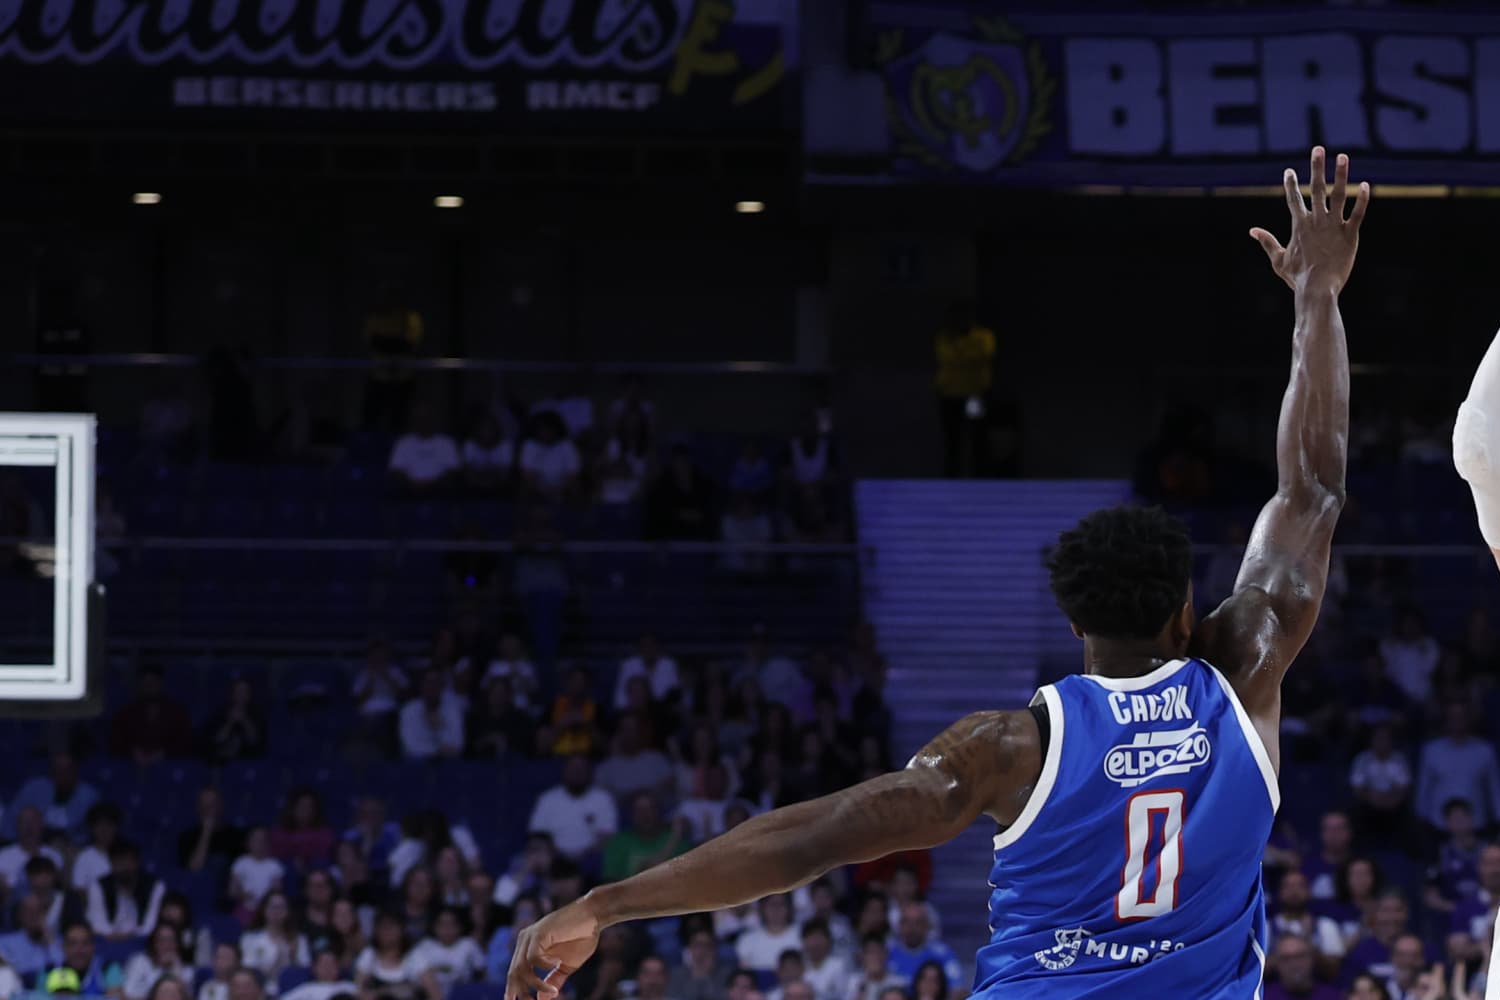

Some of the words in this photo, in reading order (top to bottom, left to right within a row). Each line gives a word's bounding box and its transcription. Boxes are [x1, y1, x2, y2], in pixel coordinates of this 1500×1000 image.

[172, 75, 497, 112] BERSERKERS
[525, 79, 662, 112] RMCF
[1114, 788, 1187, 923] 0
